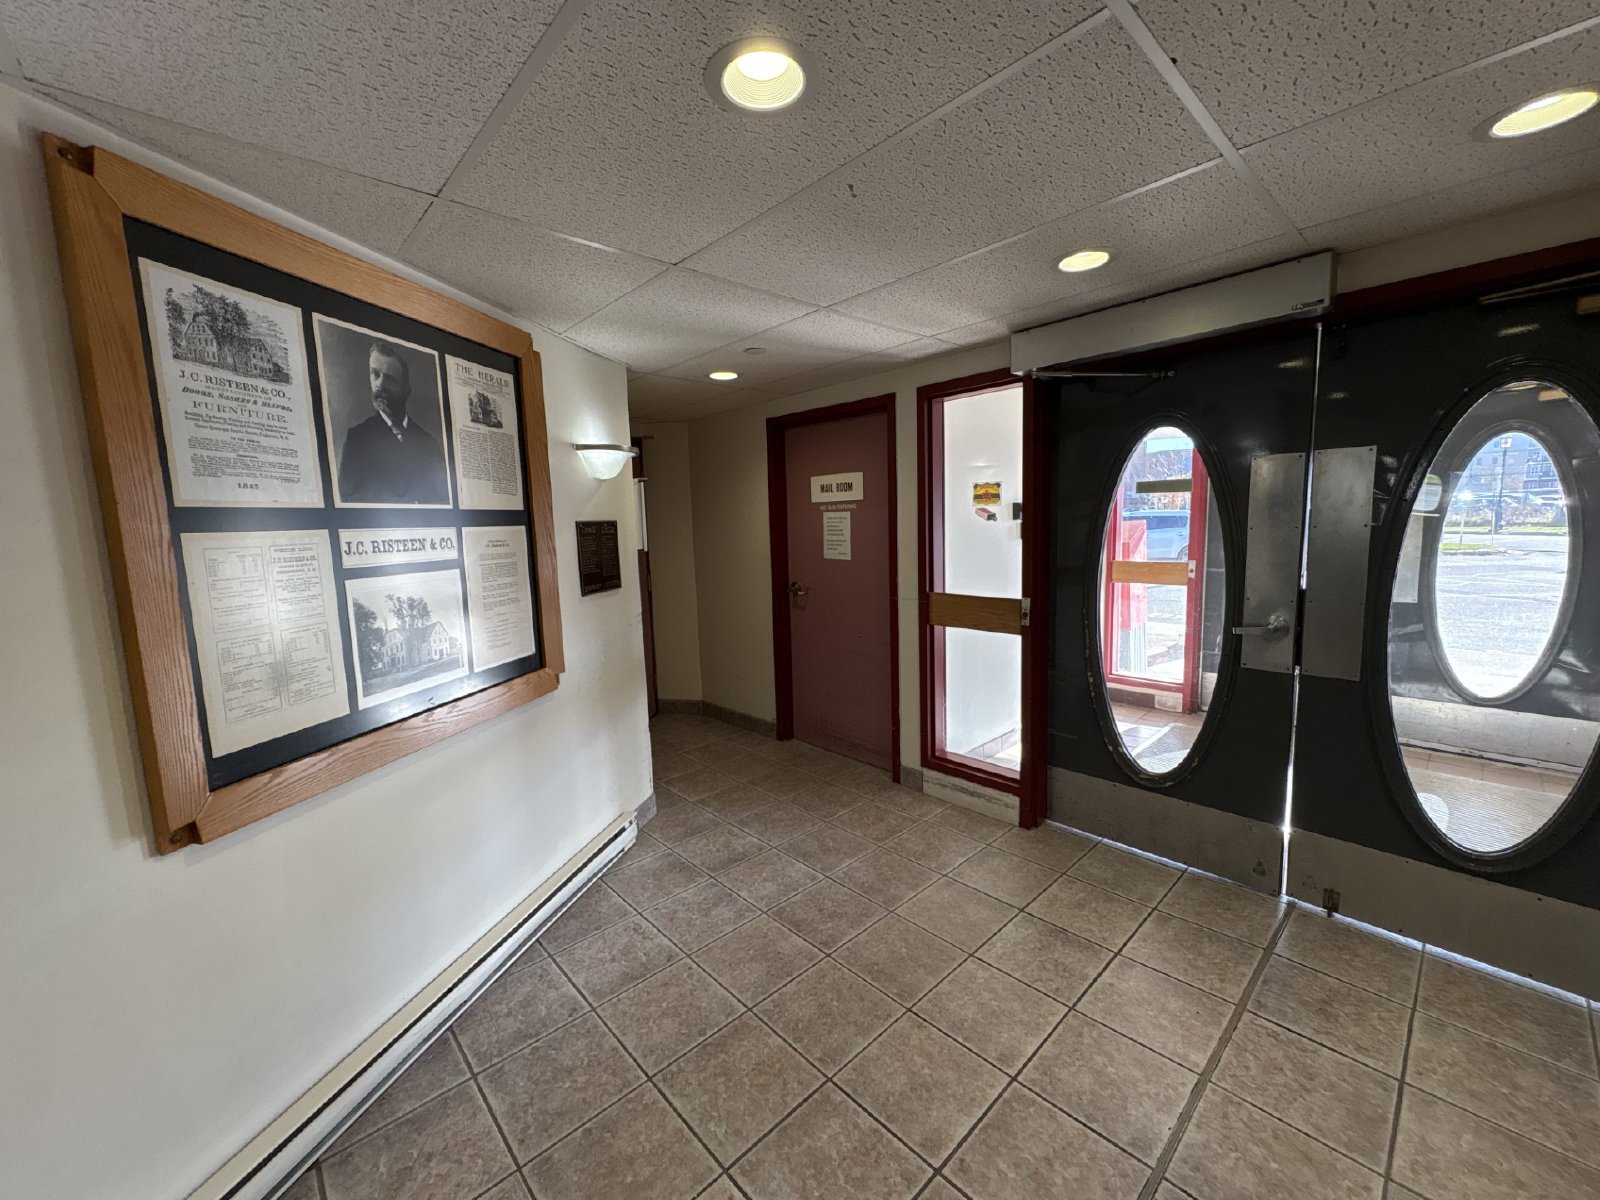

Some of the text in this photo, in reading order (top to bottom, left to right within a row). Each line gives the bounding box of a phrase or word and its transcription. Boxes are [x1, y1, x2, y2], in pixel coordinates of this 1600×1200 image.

[455, 362, 509, 388] THE HERALD
[204, 375, 259, 394] RISTEEN
[260, 387, 270, 395] &
[820, 482, 853, 493] MAIL ROOM
[371, 538, 427, 554] RISTEEN
[429, 538, 437, 550] &
[439, 537, 455, 550] CO.
